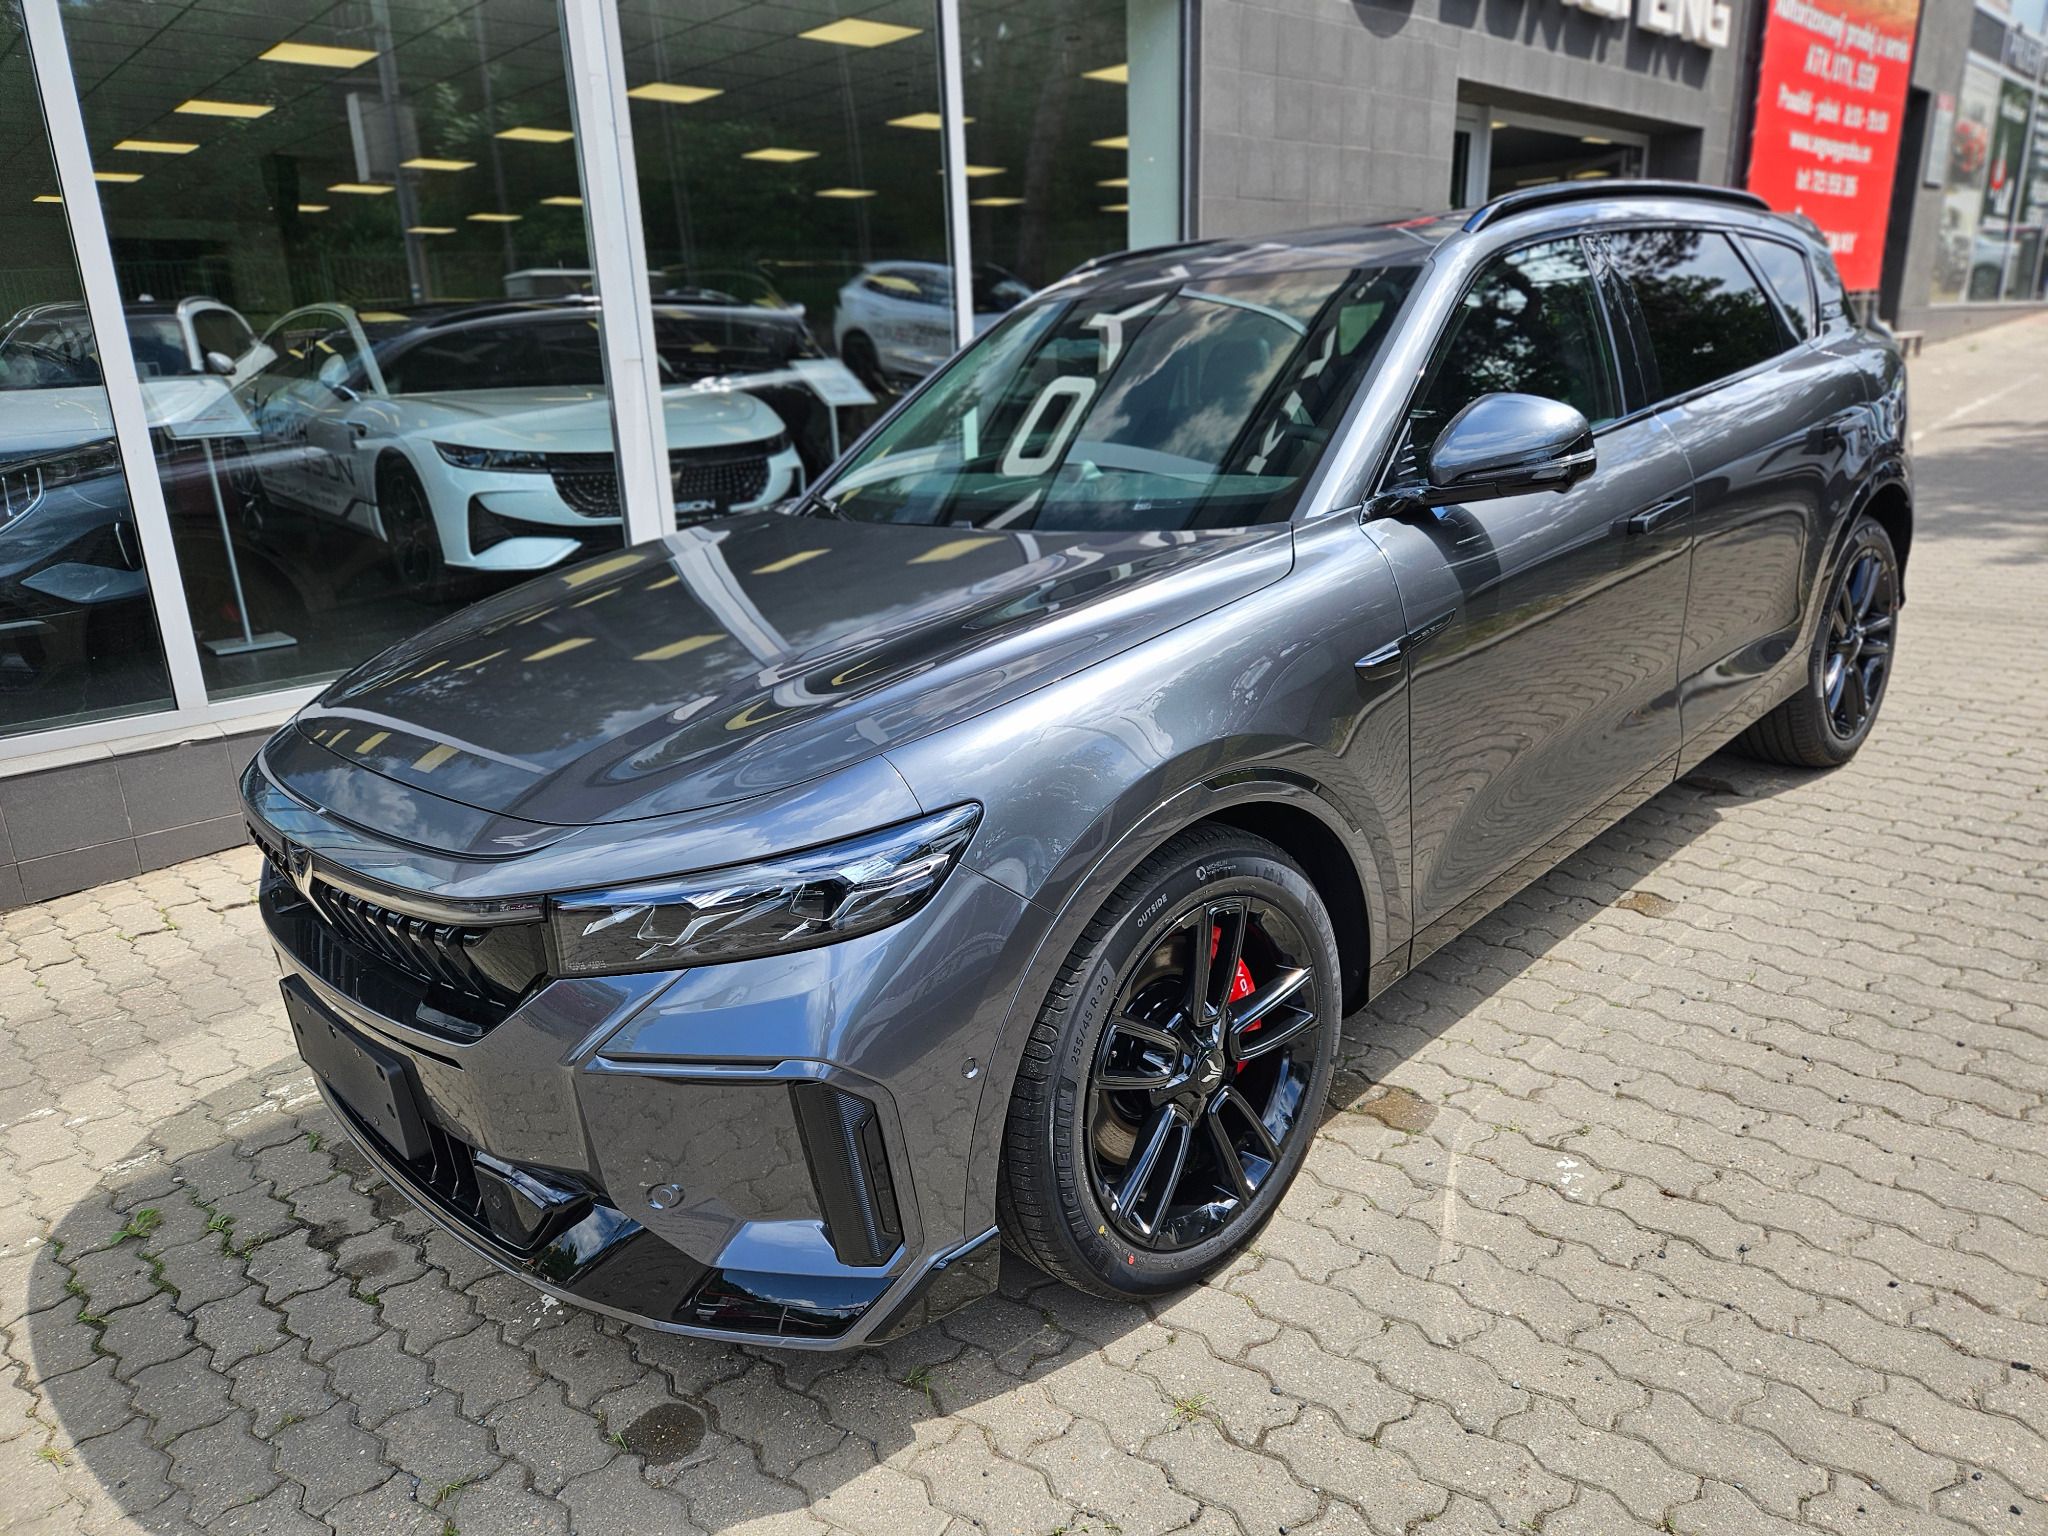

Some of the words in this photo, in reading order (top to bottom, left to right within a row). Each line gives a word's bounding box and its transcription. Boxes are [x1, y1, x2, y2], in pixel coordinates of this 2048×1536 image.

[1136, 893, 1169, 928] OUTSIDE
[1070, 1010, 1094, 1066] 255/45
[1090, 996, 1099, 1009] R
[1096, 975, 1109, 996] 20
[1055, 1088, 1092, 1242] MICHELIN
